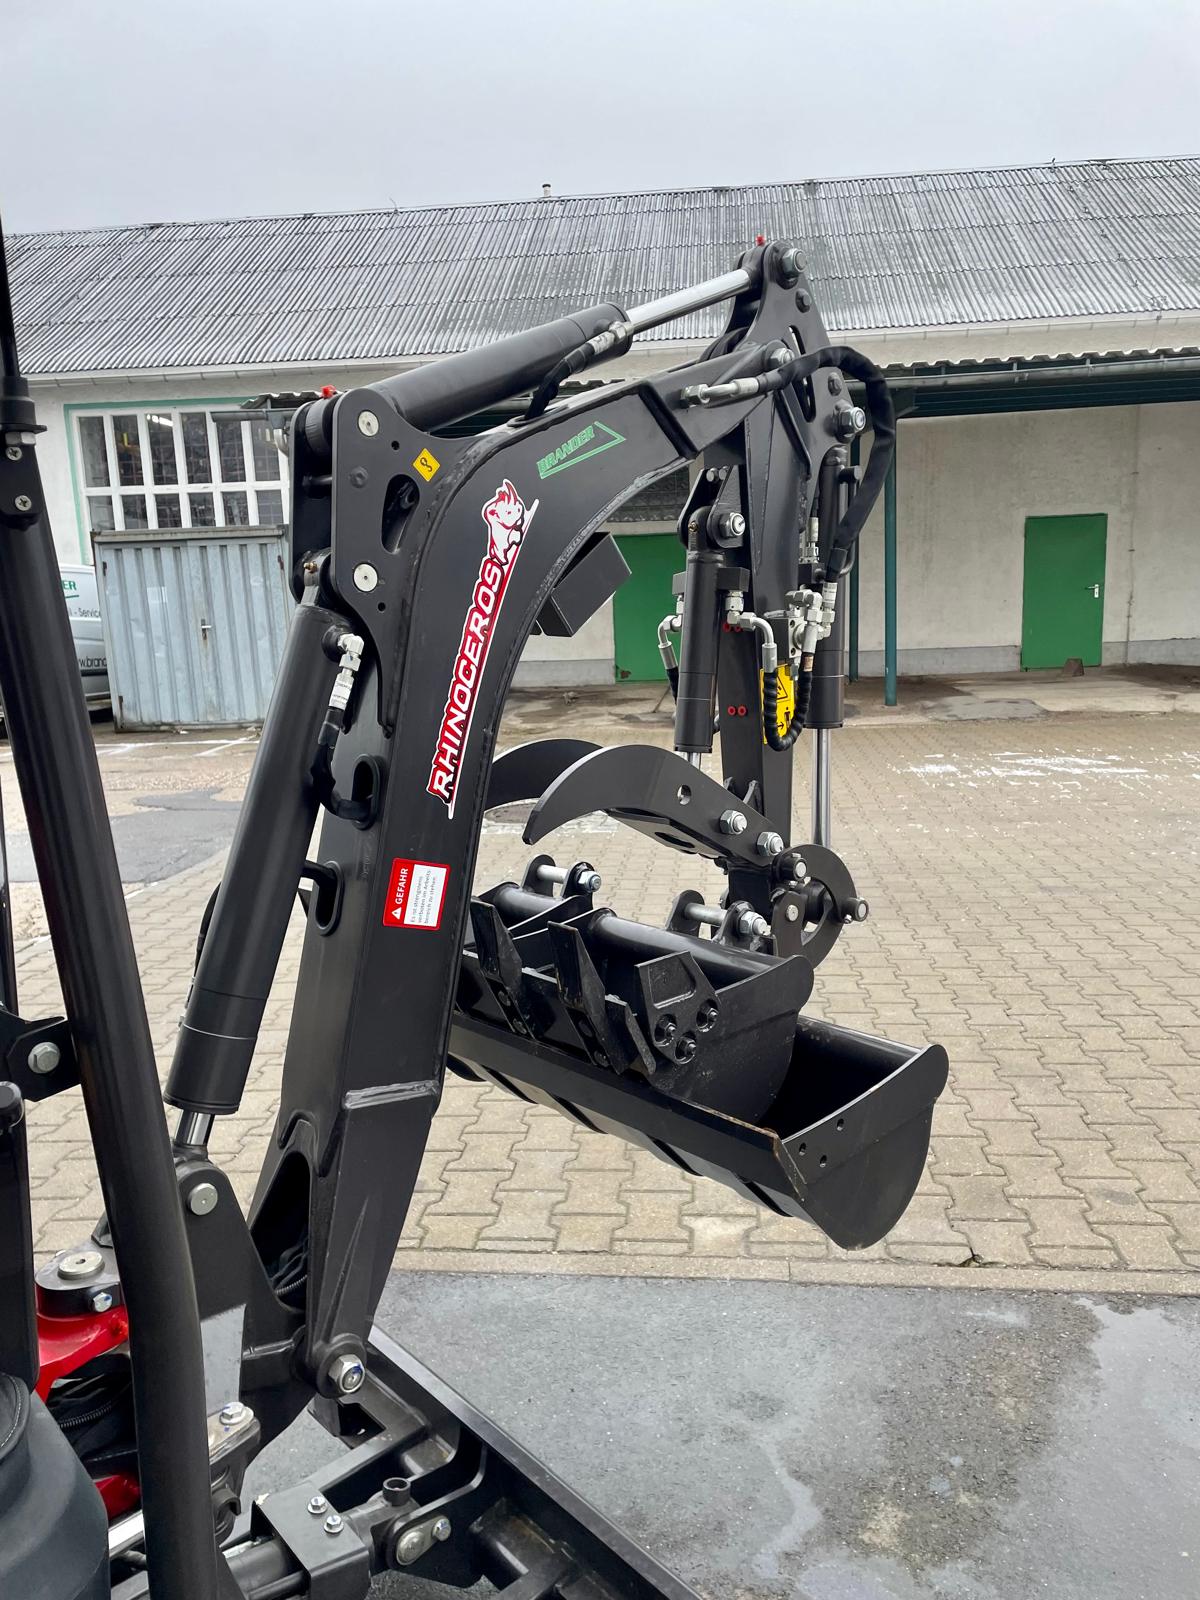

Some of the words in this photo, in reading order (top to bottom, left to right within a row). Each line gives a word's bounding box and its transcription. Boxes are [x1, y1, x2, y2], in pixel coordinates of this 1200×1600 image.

[62, 580, 77, 590] ER
[431, 559, 504, 799] RHINOCEROS
[395, 868, 409, 905] GEFAHR
